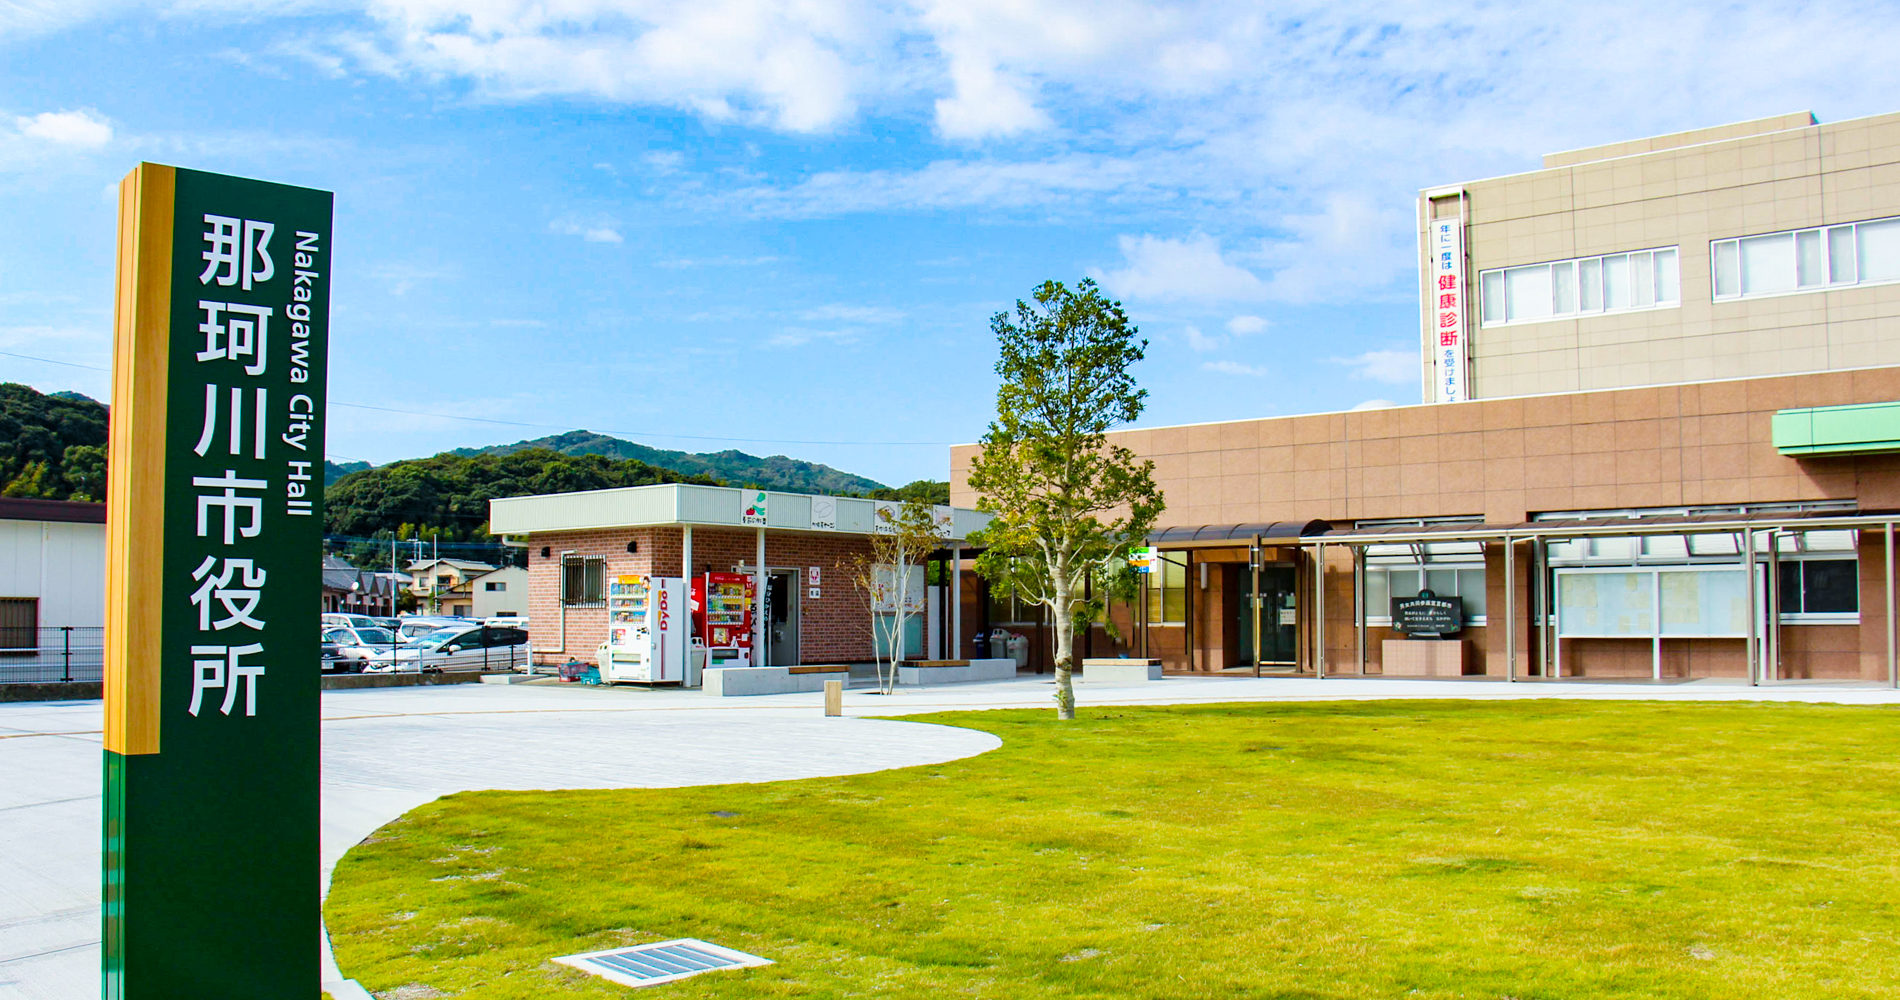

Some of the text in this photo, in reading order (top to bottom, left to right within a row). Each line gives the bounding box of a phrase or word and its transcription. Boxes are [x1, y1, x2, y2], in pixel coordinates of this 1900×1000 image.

[188, 213, 275, 718] 那珂川市役所
[282, 230, 319, 516] Nakagawa City Hall
[660, 590, 670, 631] DyDo
